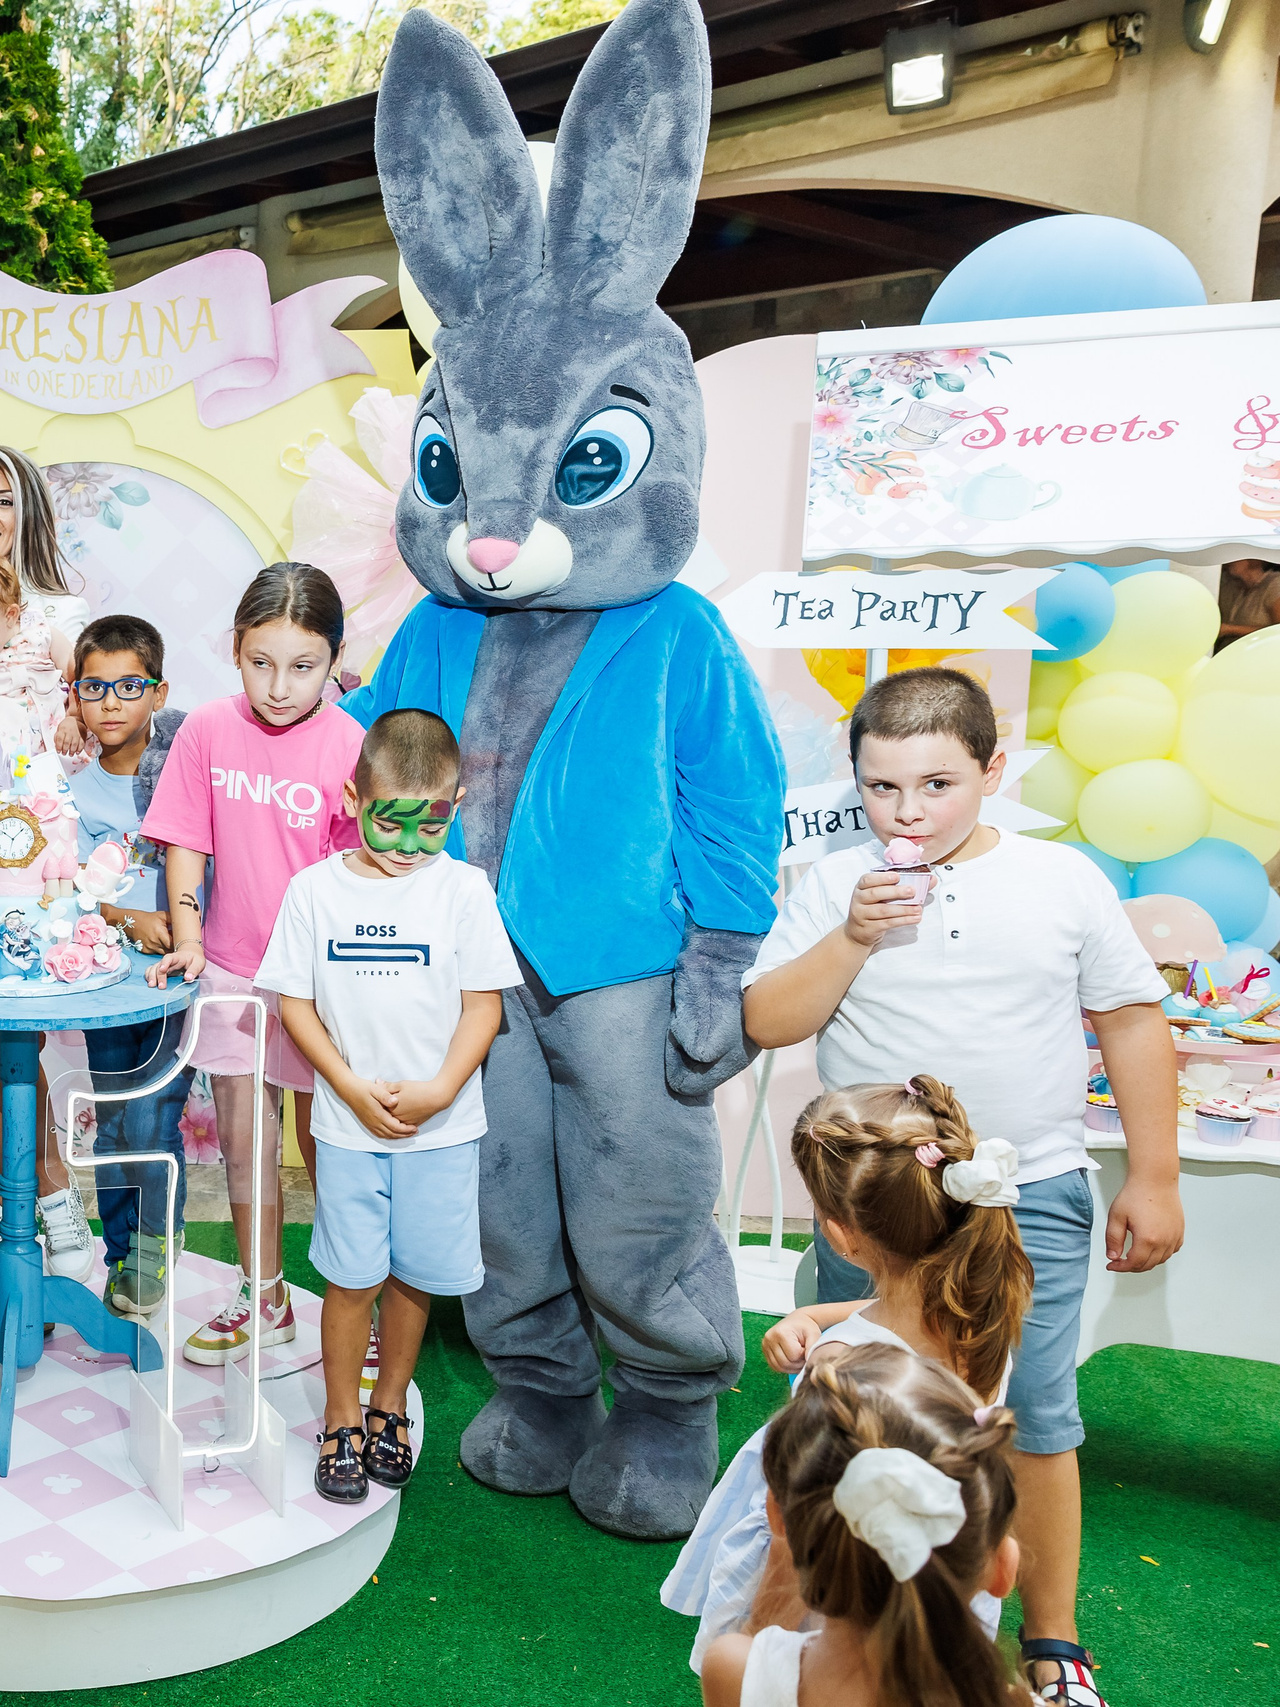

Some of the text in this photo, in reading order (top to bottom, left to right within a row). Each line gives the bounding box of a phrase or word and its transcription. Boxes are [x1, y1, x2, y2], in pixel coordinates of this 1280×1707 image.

[5, 364, 175, 400] IN ONEDERLAND
[949, 406, 1180, 450] Sweets
[210, 767, 322, 815] PINKO
[287, 812, 315, 830] UP
[355, 924, 397, 937] BOSS
[379, 1440, 397, 1453] BOSS
[336, 1458, 355, 1466] BOSS
